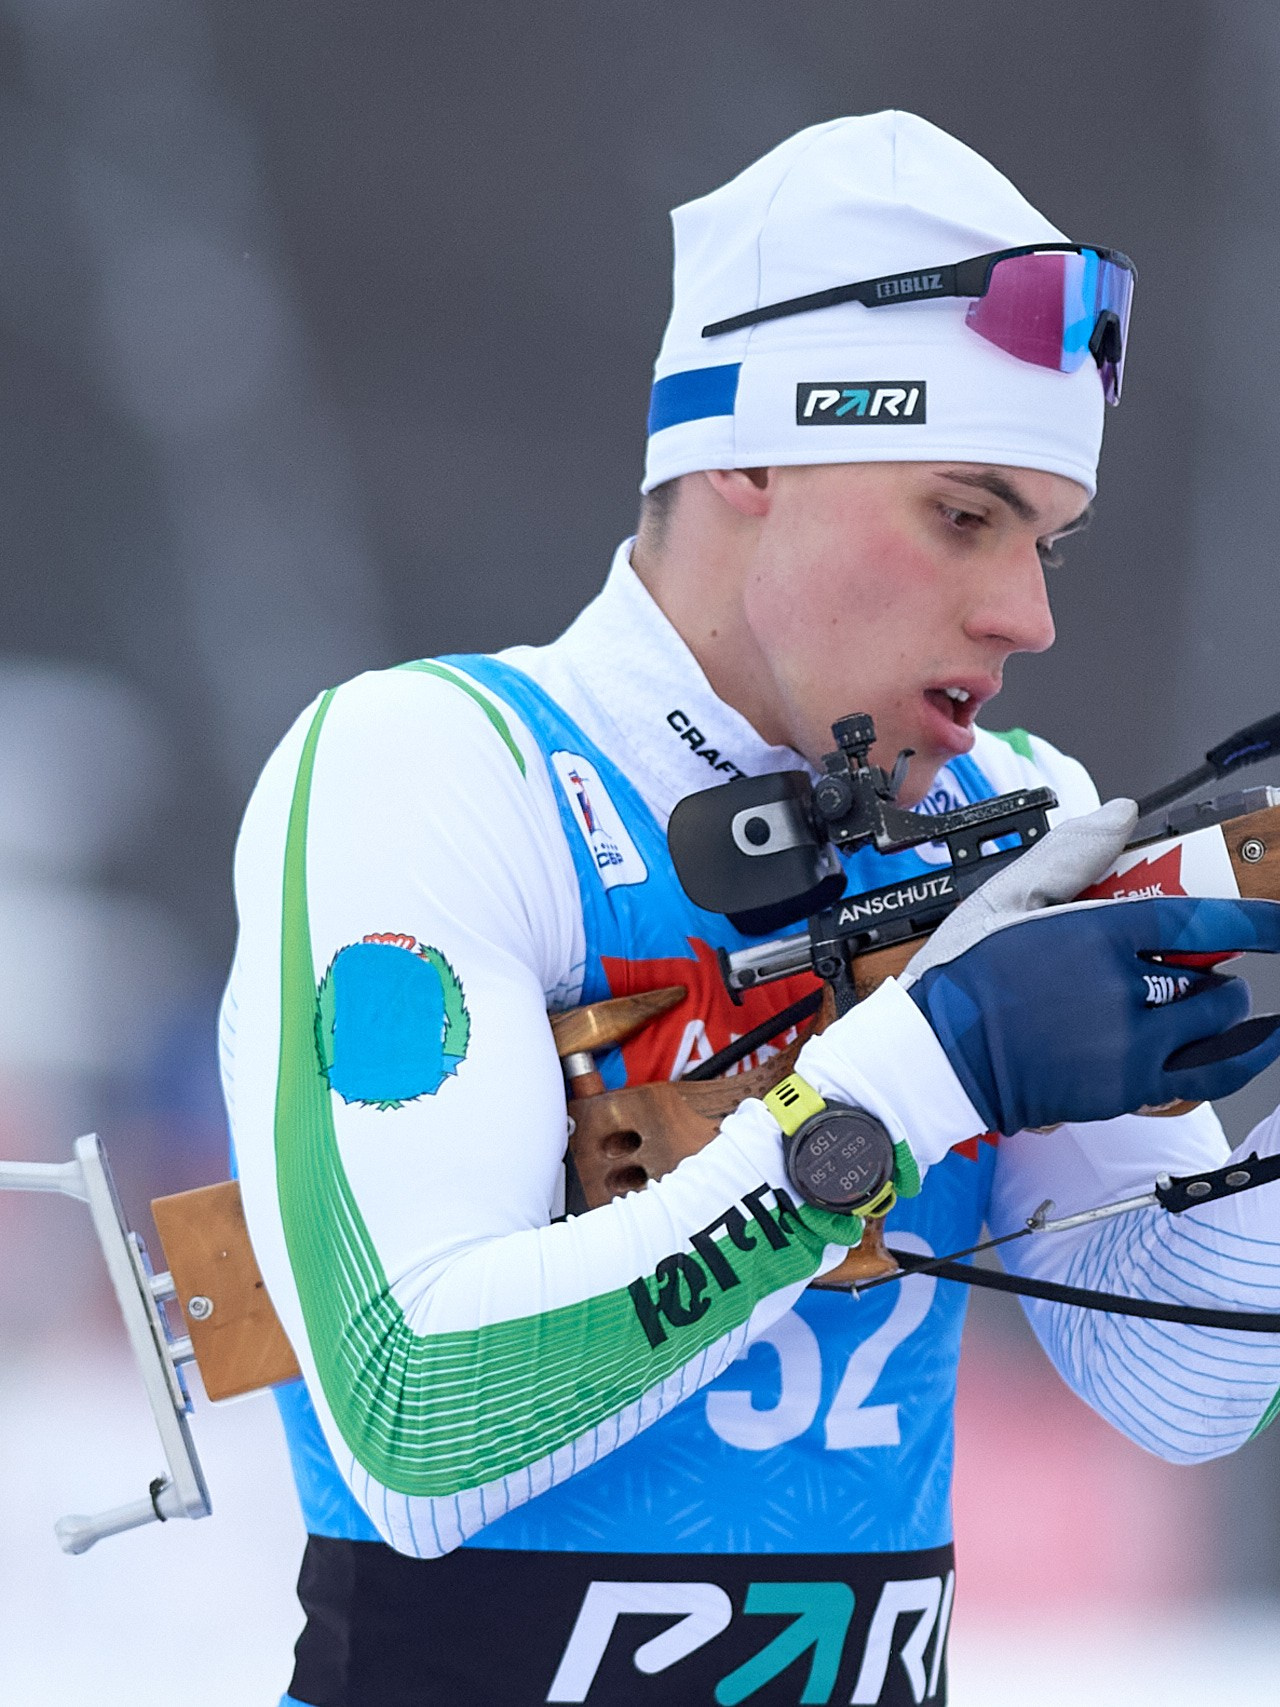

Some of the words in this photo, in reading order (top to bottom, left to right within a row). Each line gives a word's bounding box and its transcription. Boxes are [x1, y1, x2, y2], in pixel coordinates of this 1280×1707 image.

[900, 274, 944, 294] BLIZ
[803, 388, 920, 417] PARI
[666, 709, 748, 782] CRAFT
[838, 875, 954, 926] ANSCHUTZ
[809, 1130, 838, 1156] 159
[840, 1165, 869, 1191] 168
[546, 1569, 955, 1707] PARI
